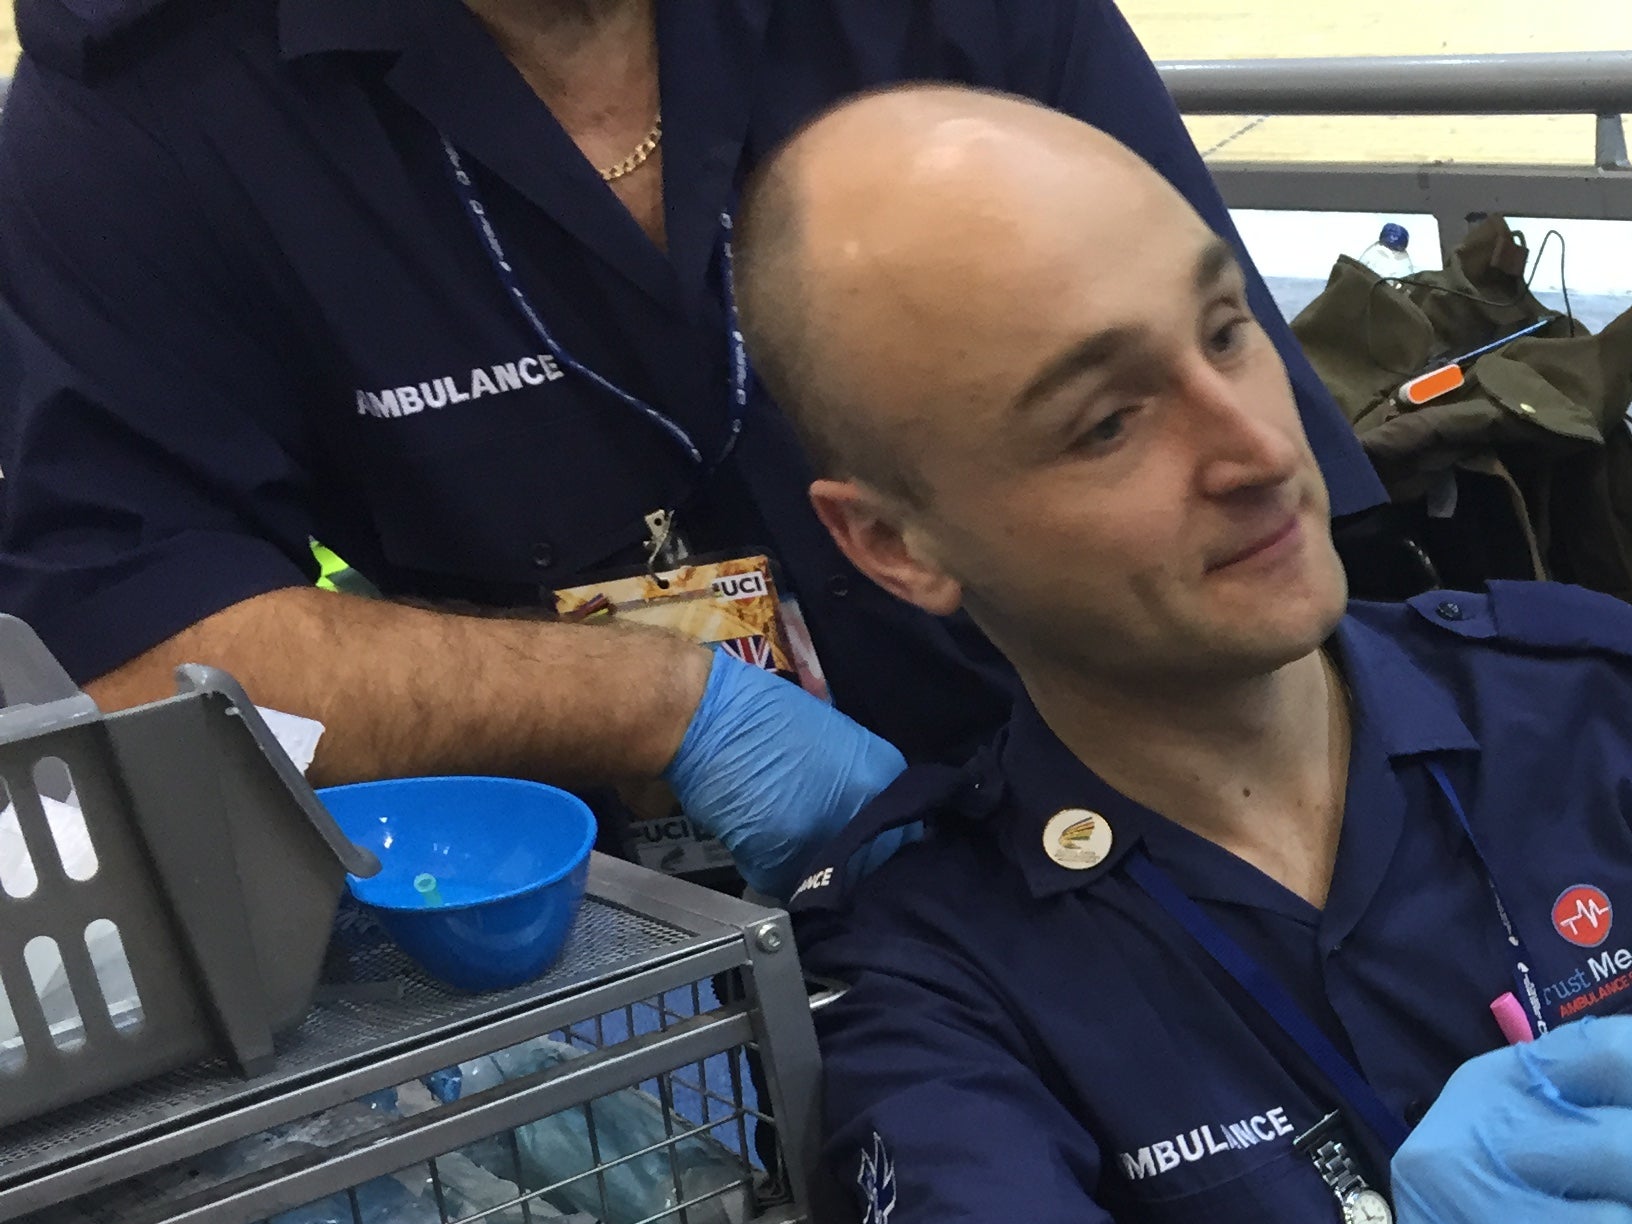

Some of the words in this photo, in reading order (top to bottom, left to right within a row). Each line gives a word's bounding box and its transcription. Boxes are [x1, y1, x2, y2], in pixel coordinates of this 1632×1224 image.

[721, 576, 763, 597] UCI
[1543, 968, 1591, 1006] rust
[1559, 977, 1630, 1018] AMBULANCE
[1121, 1106, 1294, 1180] MBULANCE
